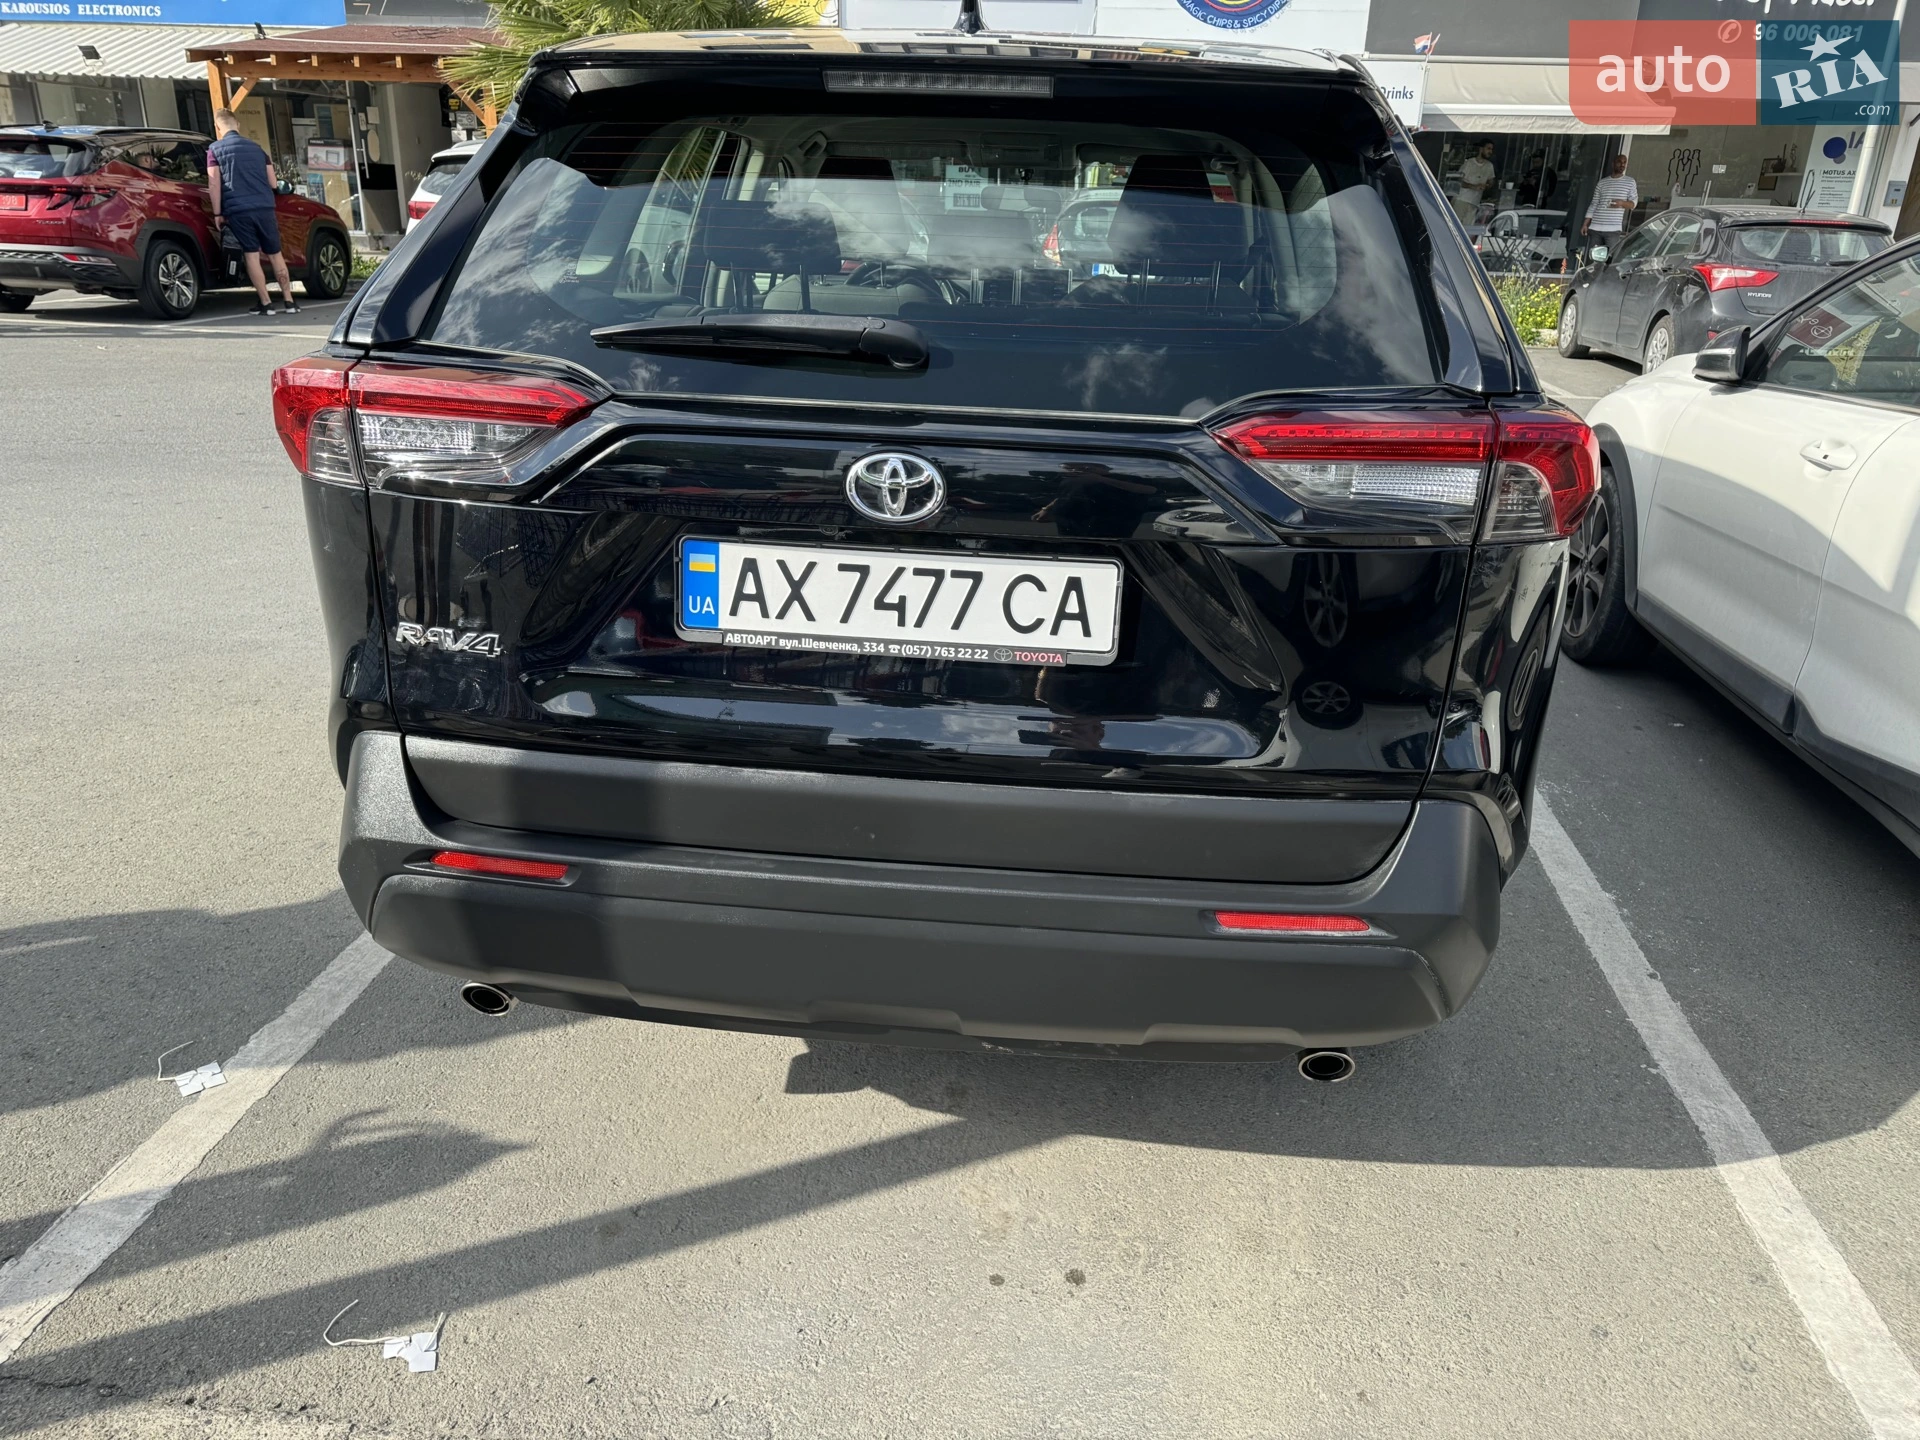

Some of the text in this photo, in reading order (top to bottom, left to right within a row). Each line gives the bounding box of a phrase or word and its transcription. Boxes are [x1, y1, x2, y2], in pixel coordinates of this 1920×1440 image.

[0, 2, 162, 17] KAROUSIOS ELECTRONICS
[1181, 0, 1206, 21] MAGIC
[1206, 15, 1232, 28] CHIPS
[1233, 19, 1241, 28] &
[1242, 9, 1267, 28] SPICY
[1747, 291, 1773, 299] HYUNDAI
[688, 595, 716, 615] UA
[728, 557, 1092, 638] AX 7477 CA
[395, 621, 502, 658] RAV4
[725, 632, 778, 646] АВТОАРТ
[863, 641, 885, 653] 334
[901, 644, 932, 658] (057)
[934, 646, 955, 658] 763
[957, 647, 972, 659] 22
[973, 648, 989, 660] 22
[1014, 651, 1064, 664] TOYOTA
